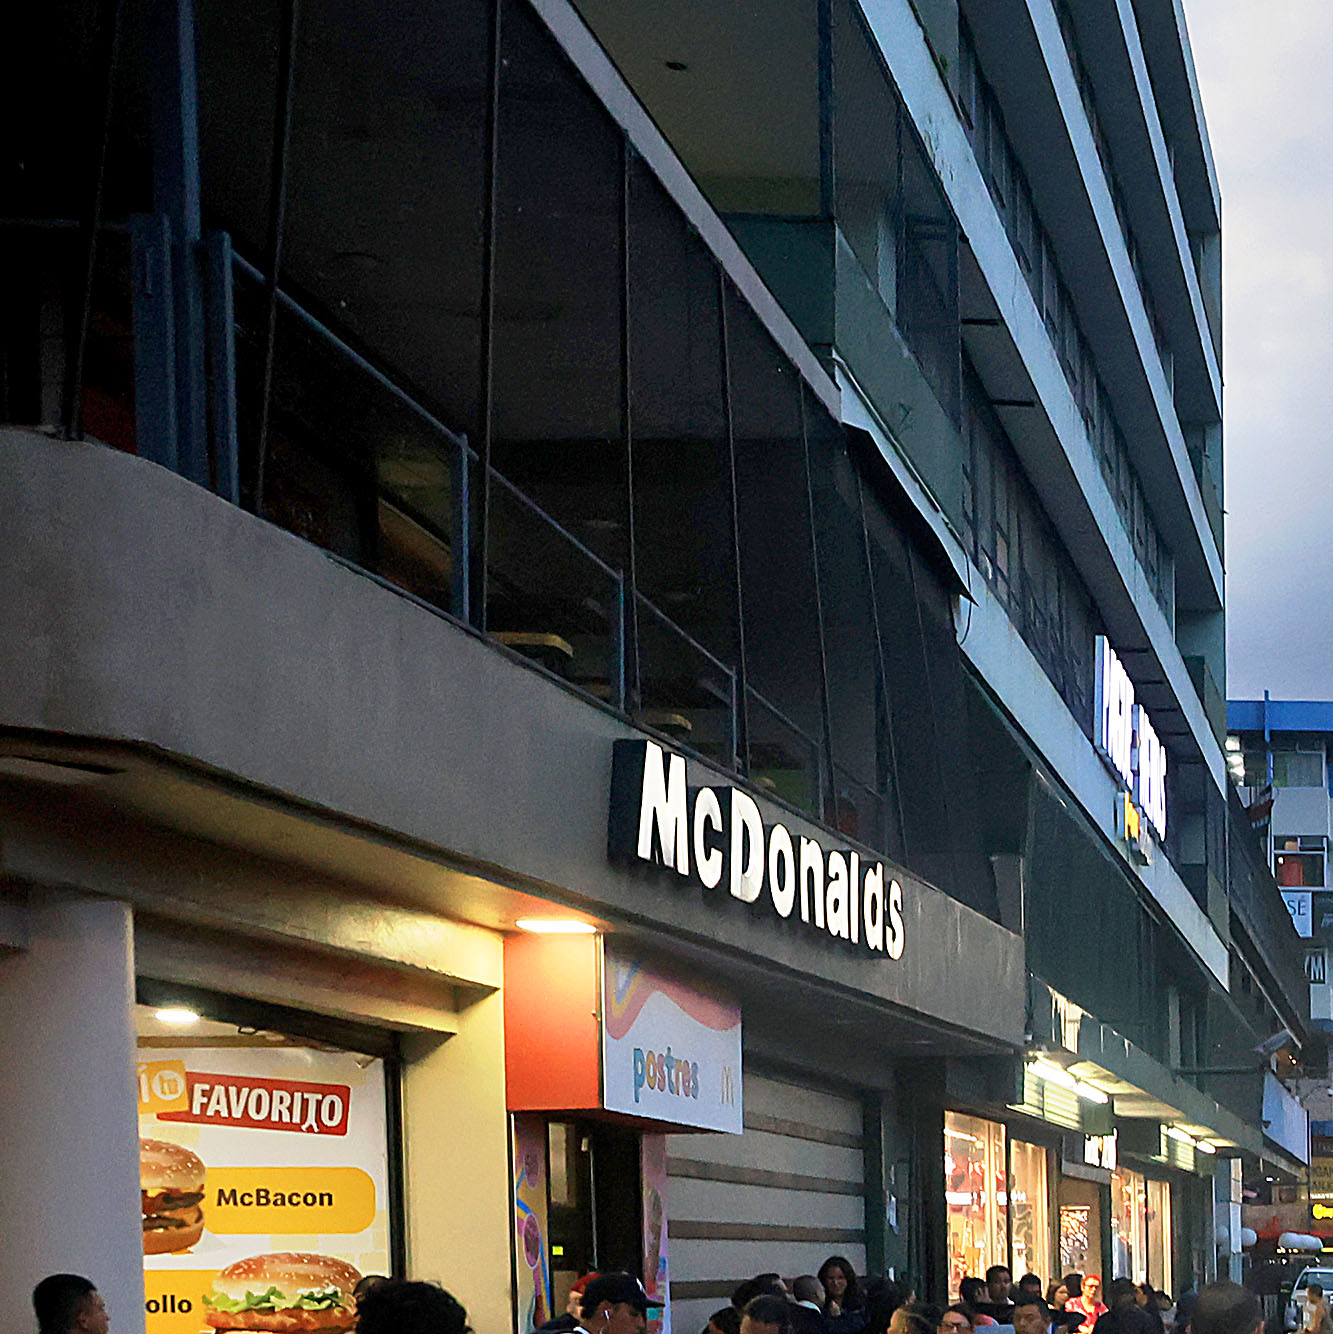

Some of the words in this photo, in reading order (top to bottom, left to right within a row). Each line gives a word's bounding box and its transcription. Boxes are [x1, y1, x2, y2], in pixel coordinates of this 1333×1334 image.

[633, 1046, 700, 1103] postres
[191, 1083, 344, 1133] FAVORITO
[216, 1188, 333, 1207] McBacon
[145, 1294, 192, 1314] ollo
